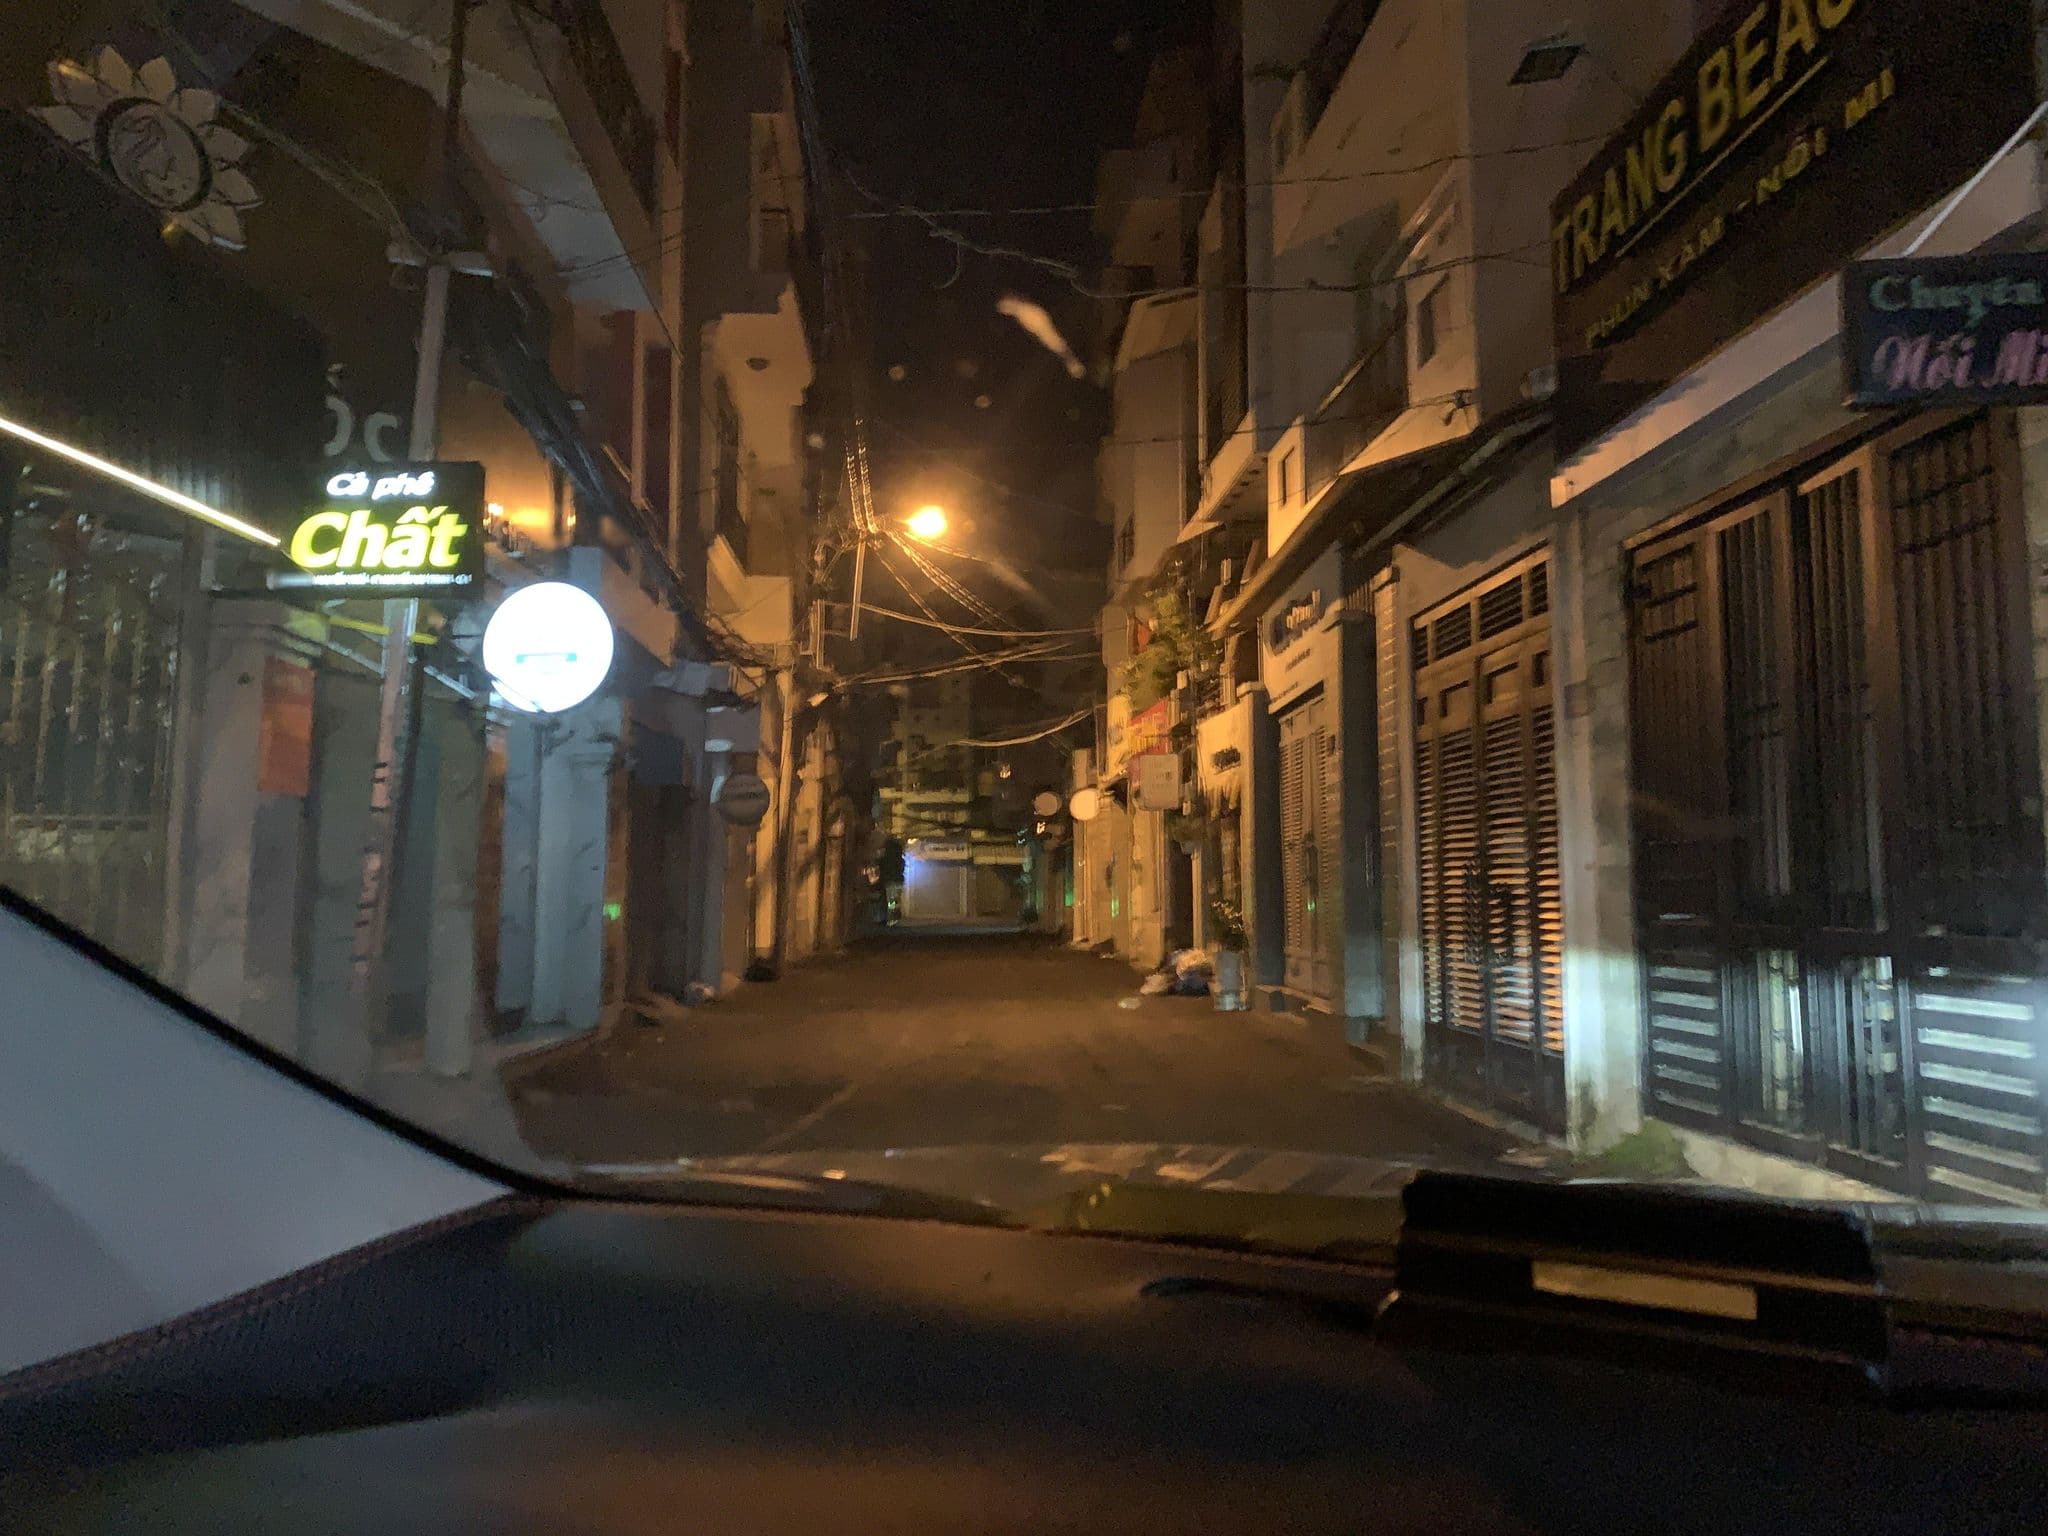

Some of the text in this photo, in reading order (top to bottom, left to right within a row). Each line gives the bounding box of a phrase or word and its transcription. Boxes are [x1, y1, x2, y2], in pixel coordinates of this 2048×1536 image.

[1844, 68, 1896, 129] MI
[1551, 97, 1688, 294] TRANG
[291, 505, 468, 568] Chất
